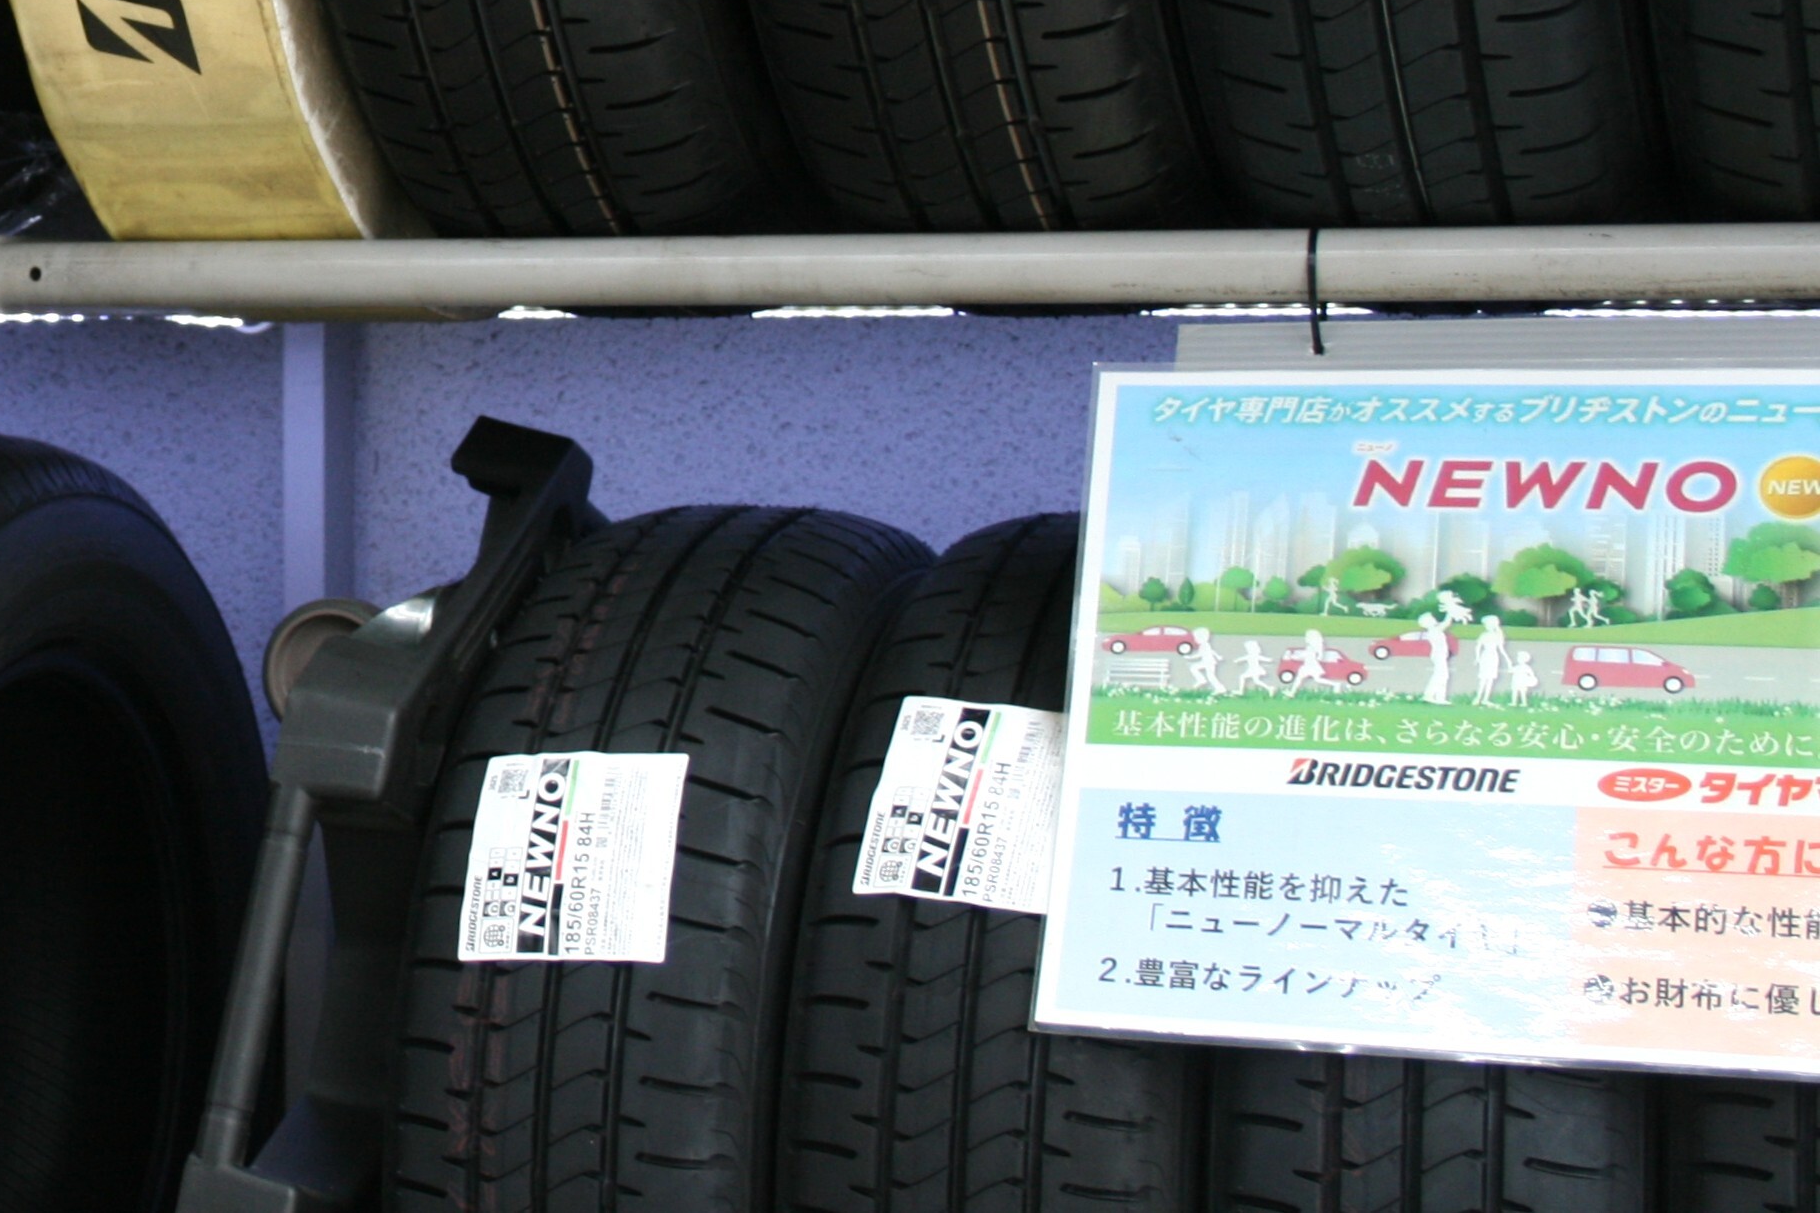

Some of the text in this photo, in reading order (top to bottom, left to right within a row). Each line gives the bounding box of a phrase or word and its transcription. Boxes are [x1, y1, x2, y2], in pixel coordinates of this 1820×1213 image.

[1352, 459, 1737, 513] NEWNO
[1112, 709, 1820, 757] 基本性能の進化は、さらなる安心・安全のために
[916, 720, 985, 878] NEWNO
[1287, 757, 1521, 794] BRIDGESTONE
[1613, 771, 1820, 807] ミスター タイヤ
[519, 772, 566, 937] NEWNO
[860, 811, 885, 887] BRIDGESTONE
[962, 762, 1012, 897] 185/60R15 84H
[465, 876, 483, 953] BRIDGESTONE
[564, 811, 596, 955] 185/60R15 84H
